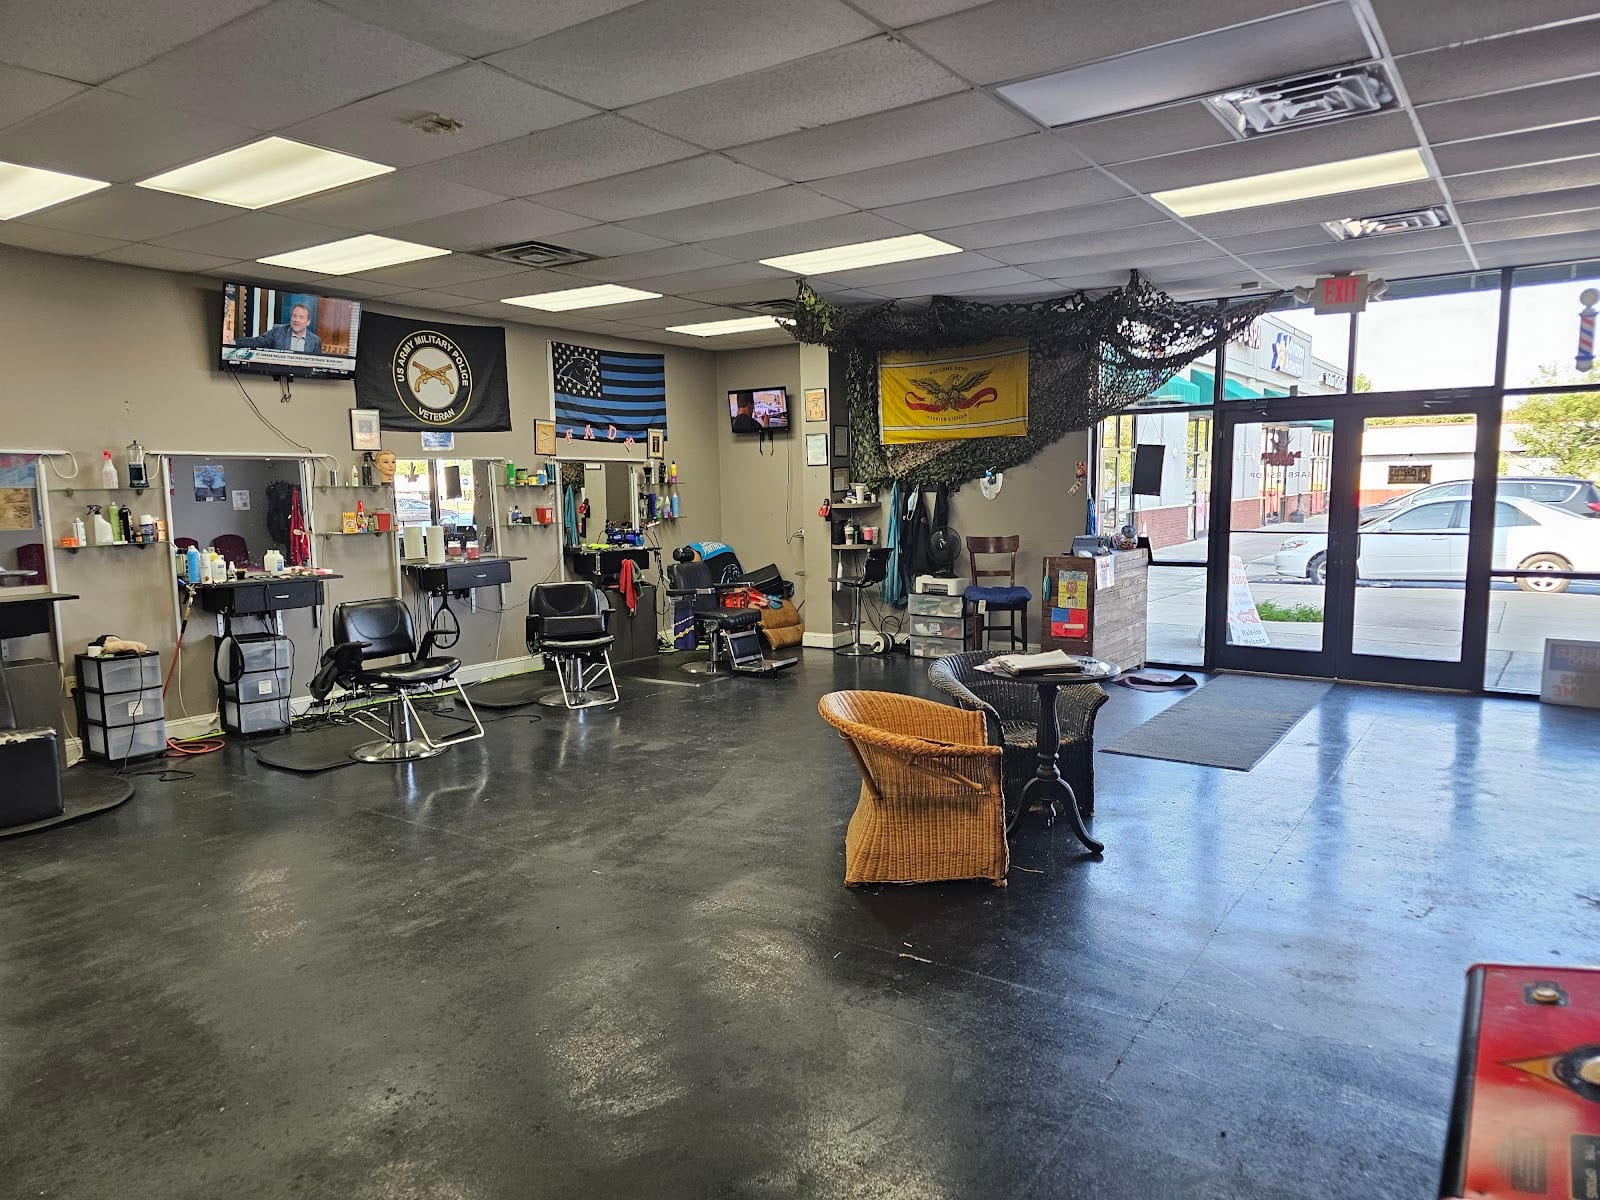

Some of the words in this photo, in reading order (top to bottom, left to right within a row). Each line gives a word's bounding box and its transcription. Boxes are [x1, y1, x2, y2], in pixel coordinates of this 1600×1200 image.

[1324, 277, 1360, 304] EXIT
[398, 340, 415, 367] ARMY
[414, 335, 454, 352] MILITARY
[396, 367, 405, 382] US
[452, 350, 469, 387] POLICE
[418, 406, 455, 421] VETERAN
